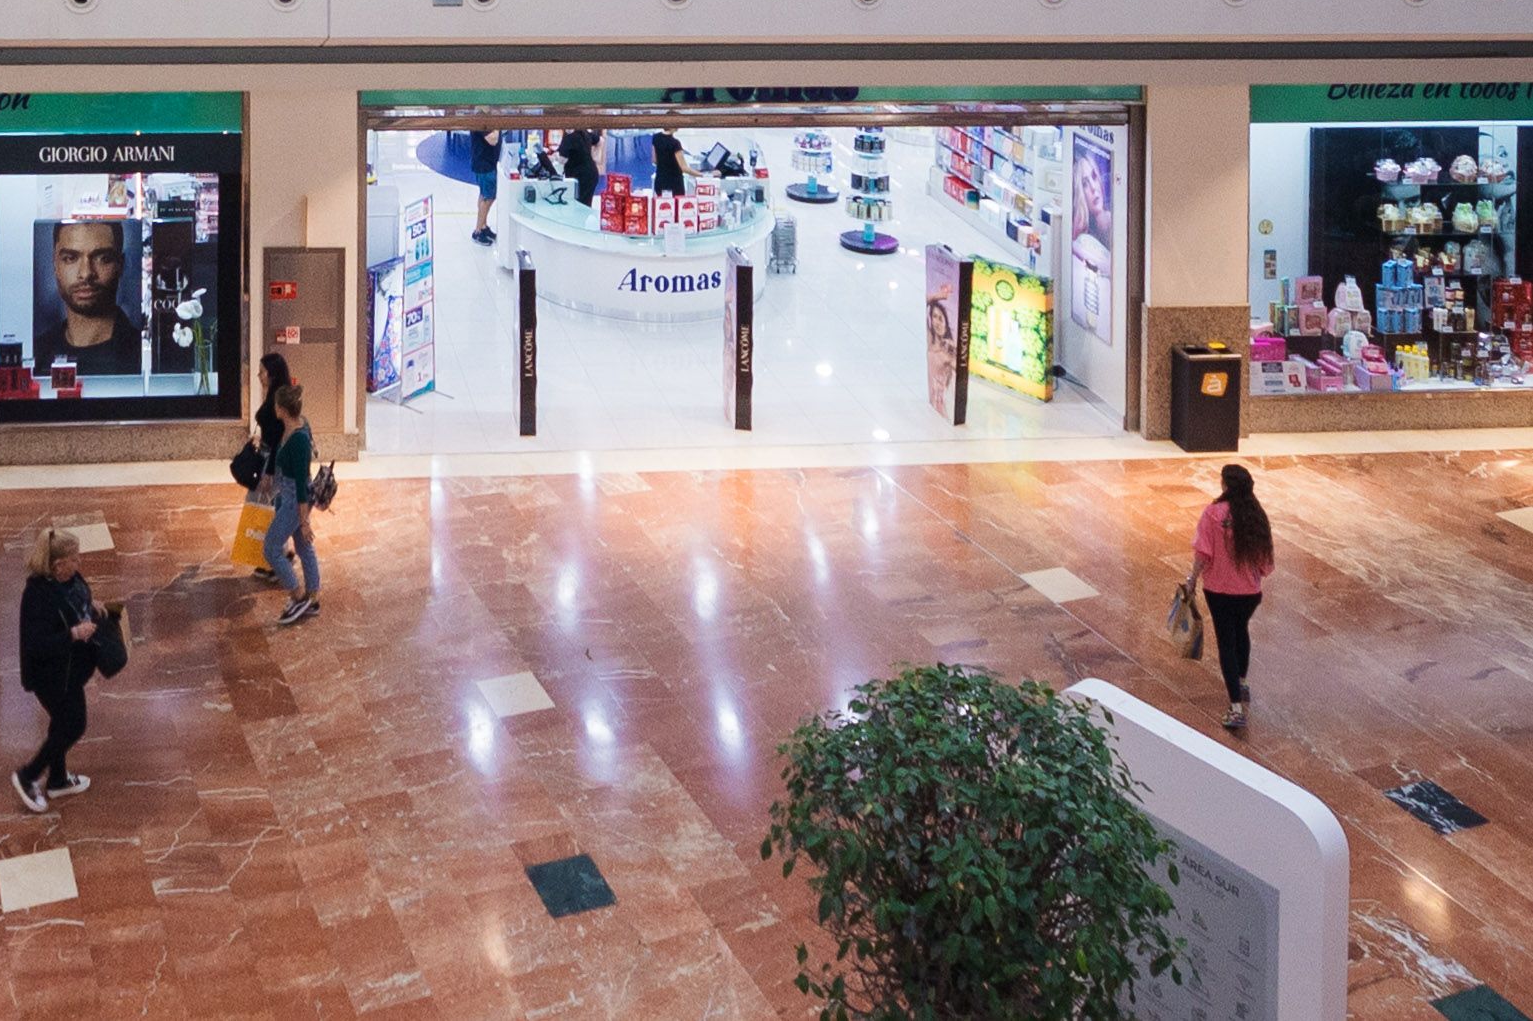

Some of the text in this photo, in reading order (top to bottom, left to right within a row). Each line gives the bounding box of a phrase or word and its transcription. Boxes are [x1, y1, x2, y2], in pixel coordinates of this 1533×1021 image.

[1422, 83, 1452, 99] en
[39, 146, 175, 162] GIORGIO ARMANI
[617, 267, 722, 294] Aromas
